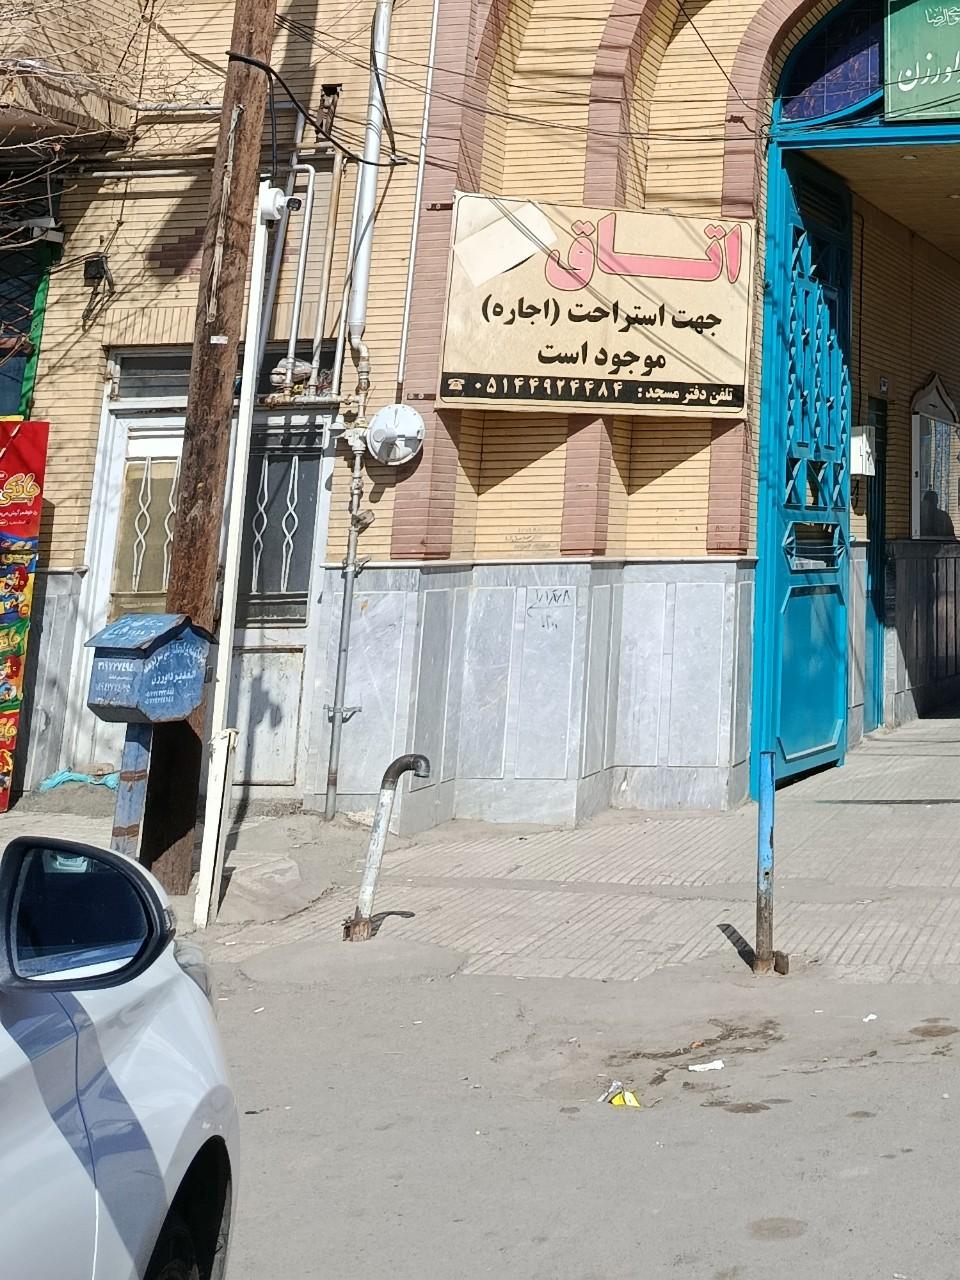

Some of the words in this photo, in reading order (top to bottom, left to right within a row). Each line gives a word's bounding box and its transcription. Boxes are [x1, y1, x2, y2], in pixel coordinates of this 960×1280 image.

[544, 211, 742, 292] اتاق
[481, 293, 561, 326] (اجاره)
[567, 299, 666, 333] استراحت
[671, 309, 722, 337] جهت
[537, 340, 588, 367] است
[594, 346, 667, 377] موجود
[681, 387, 706, 404] دفتر
[709, 387, 734, 405] تلفن
